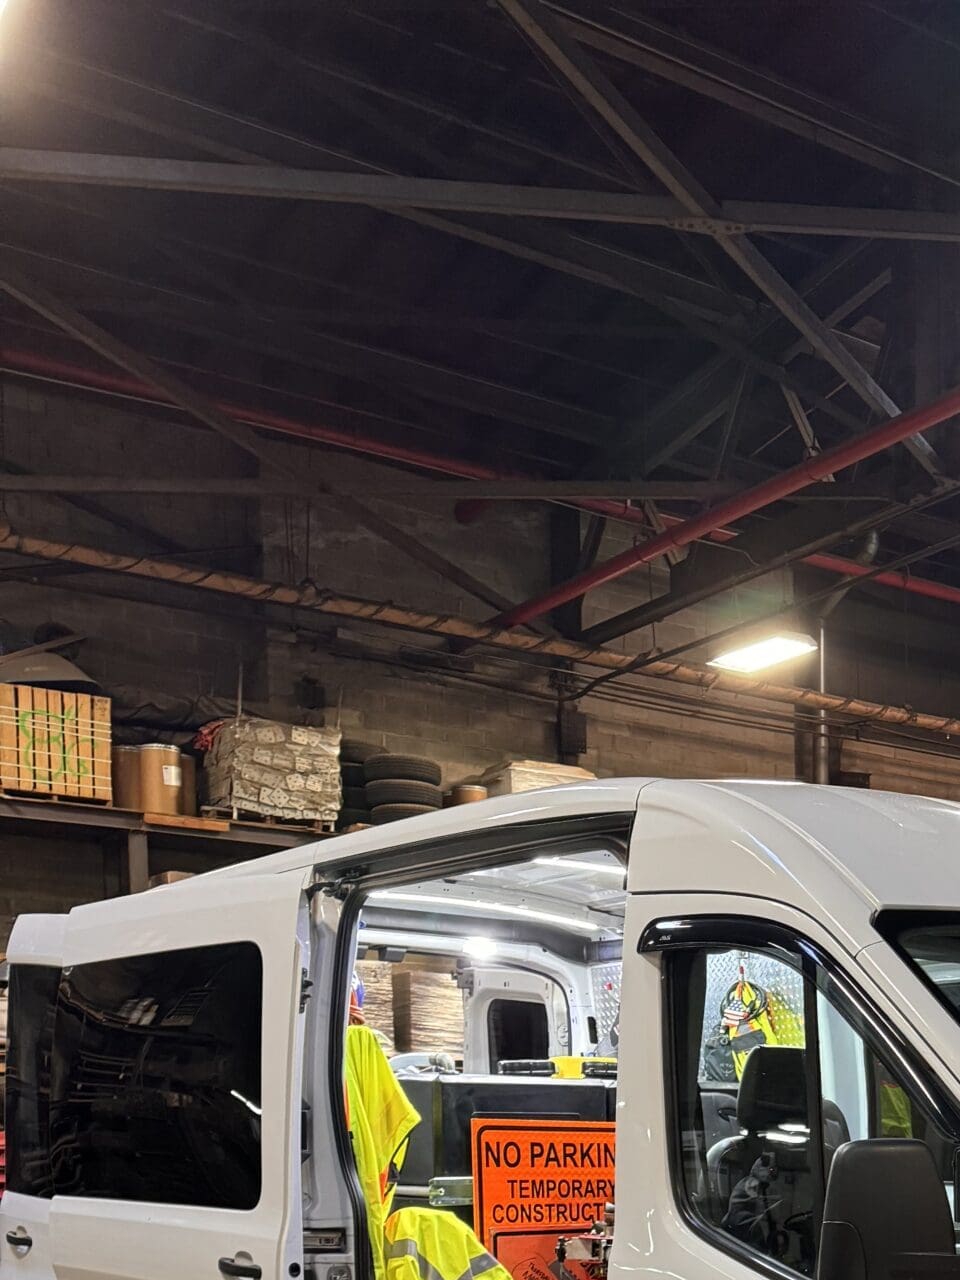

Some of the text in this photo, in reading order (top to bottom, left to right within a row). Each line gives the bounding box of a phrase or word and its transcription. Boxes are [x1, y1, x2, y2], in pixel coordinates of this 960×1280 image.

[485, 1141, 615, 1168] NO PARKIN
[507, 1179, 615, 1199] TEMPORARY
[492, 1202, 606, 1223] CONSTRUCT
